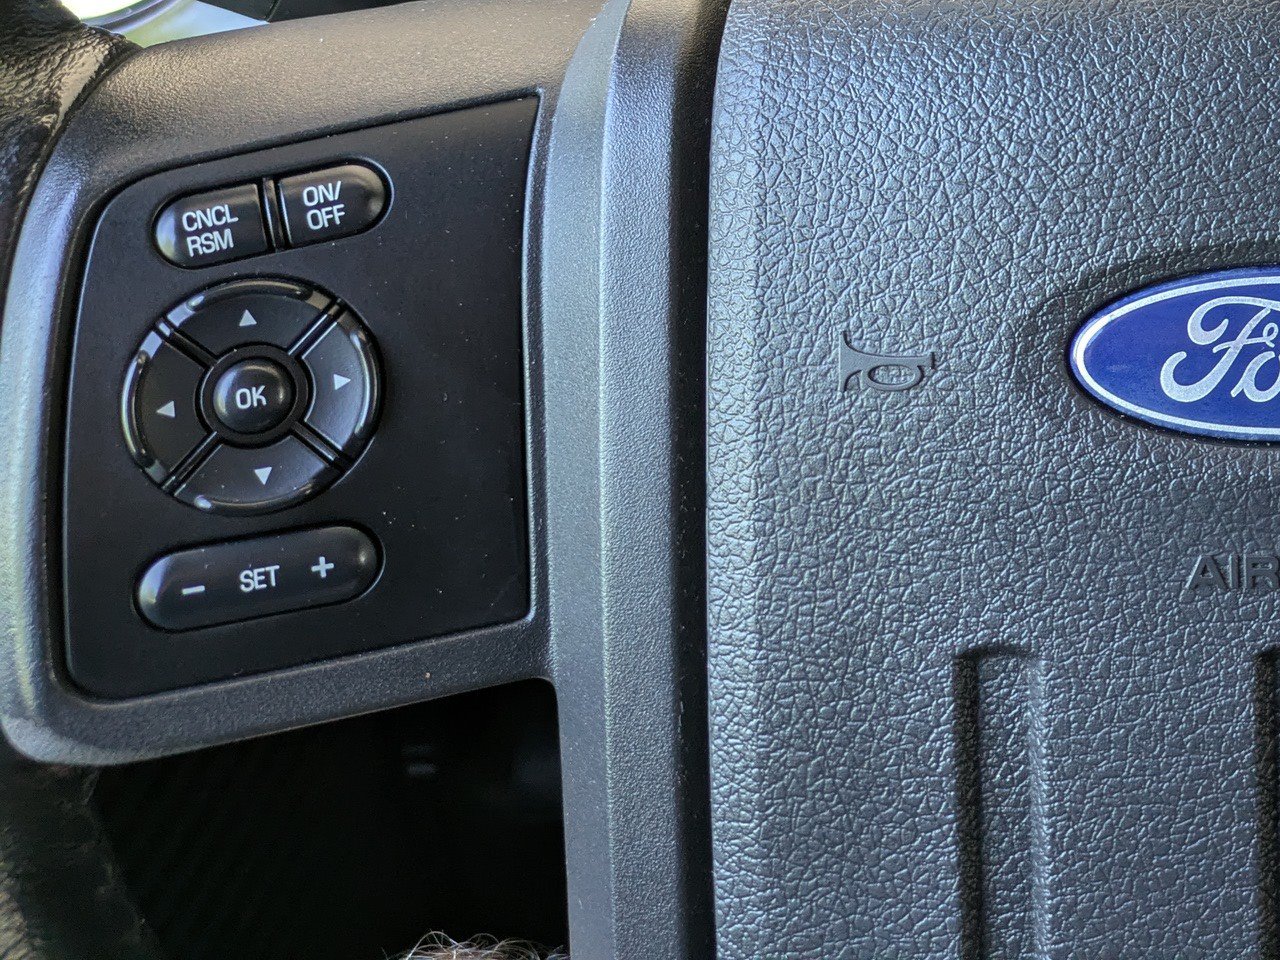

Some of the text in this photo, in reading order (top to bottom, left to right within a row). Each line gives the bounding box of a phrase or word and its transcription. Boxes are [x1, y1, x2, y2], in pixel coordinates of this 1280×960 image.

[302, 180, 342, 207] ON/
[181, 204, 239, 233] CNCL
[305, 204, 346, 231] OFF
[186, 229, 234, 257] RSM
[235, 385, 268, 410] OK
[239, 565, 280, 593] SET
